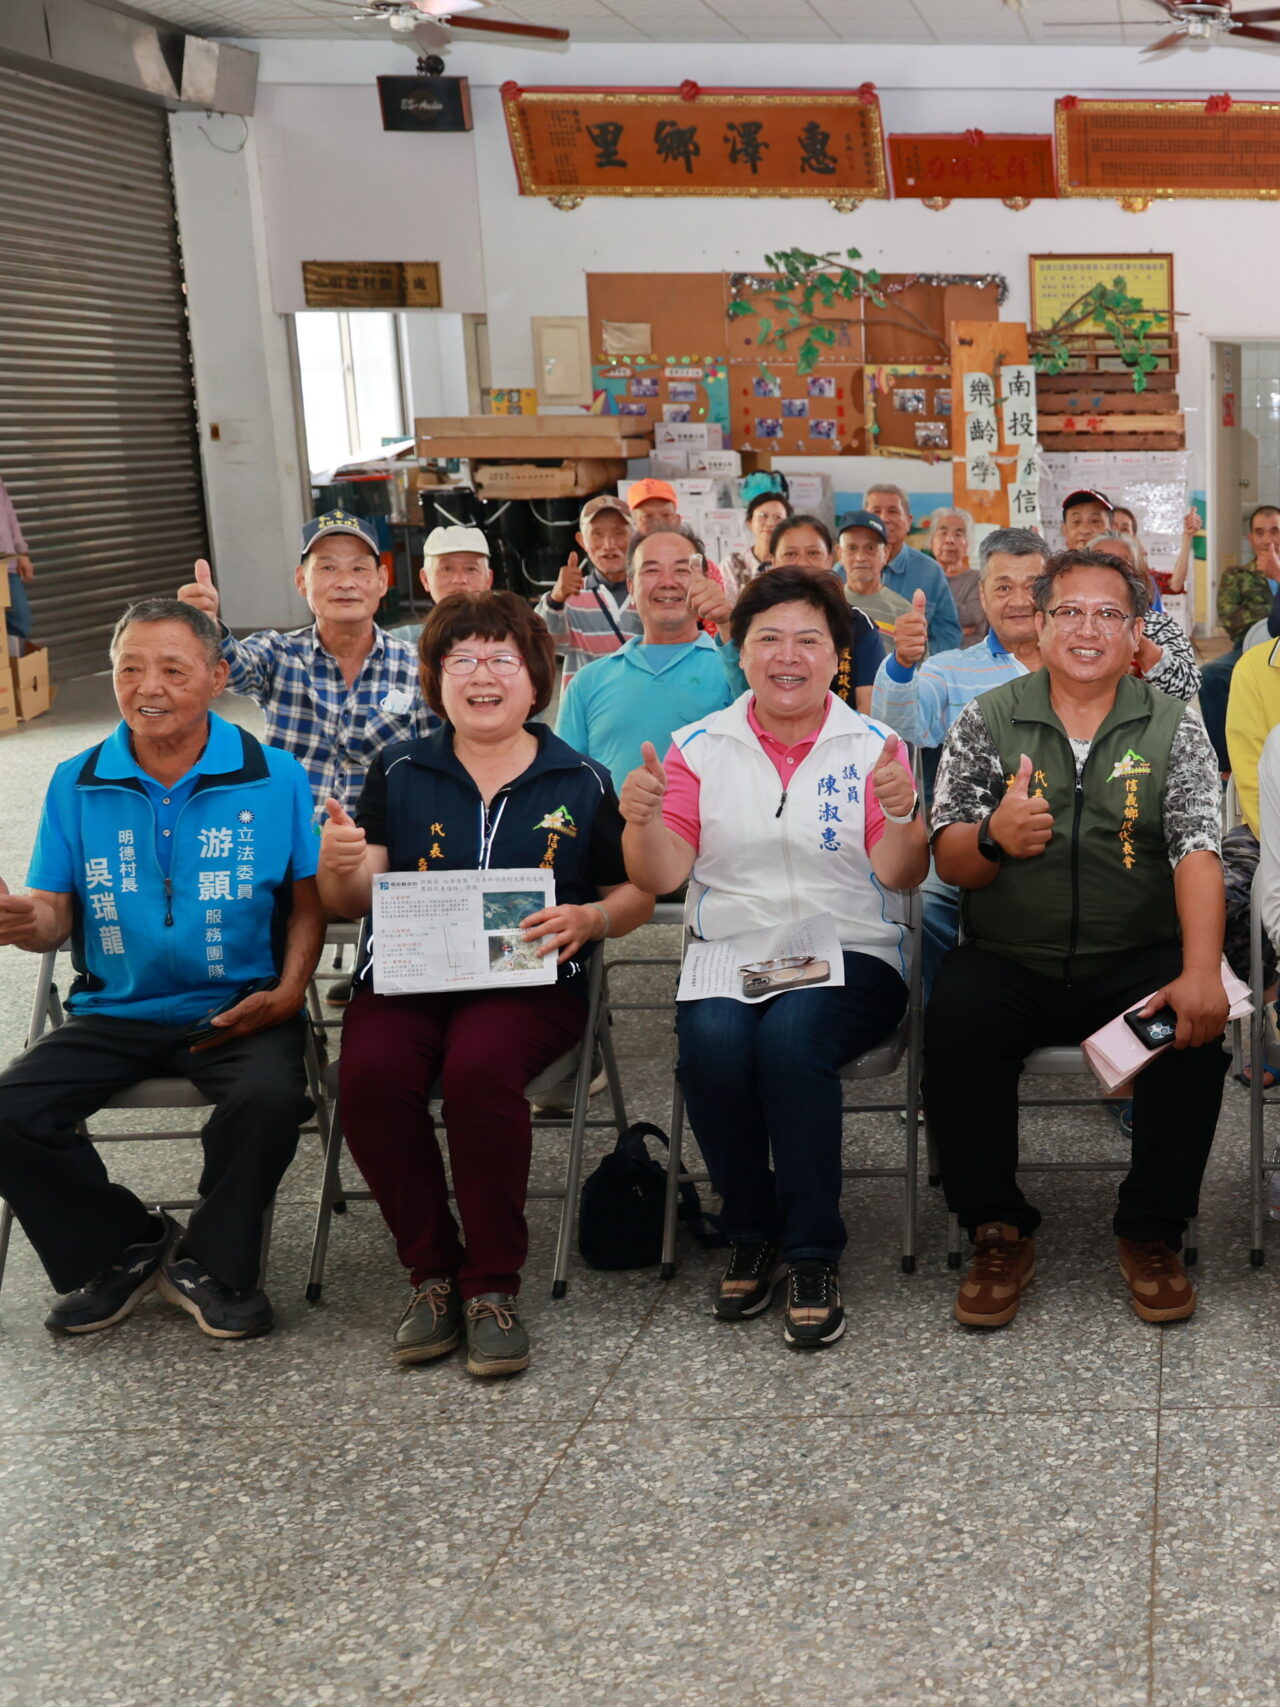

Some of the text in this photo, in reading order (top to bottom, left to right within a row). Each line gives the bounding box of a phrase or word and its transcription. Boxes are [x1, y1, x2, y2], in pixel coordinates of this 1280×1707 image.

[817, 774, 843, 852] 陳淑惠
[841, 763, 861, 804] 議員
[117, 829, 139, 893] 明德村長
[429, 822, 446, 859] 代表
[1118, 779, 1139, 870] 信義鄉民代表會
[196, 827, 236, 901] 游顥
[235, 826, 256, 900] 立法委員
[85, 857, 126, 955] 吳瑞龍
[204, 909, 226, 979] 服務團隊
